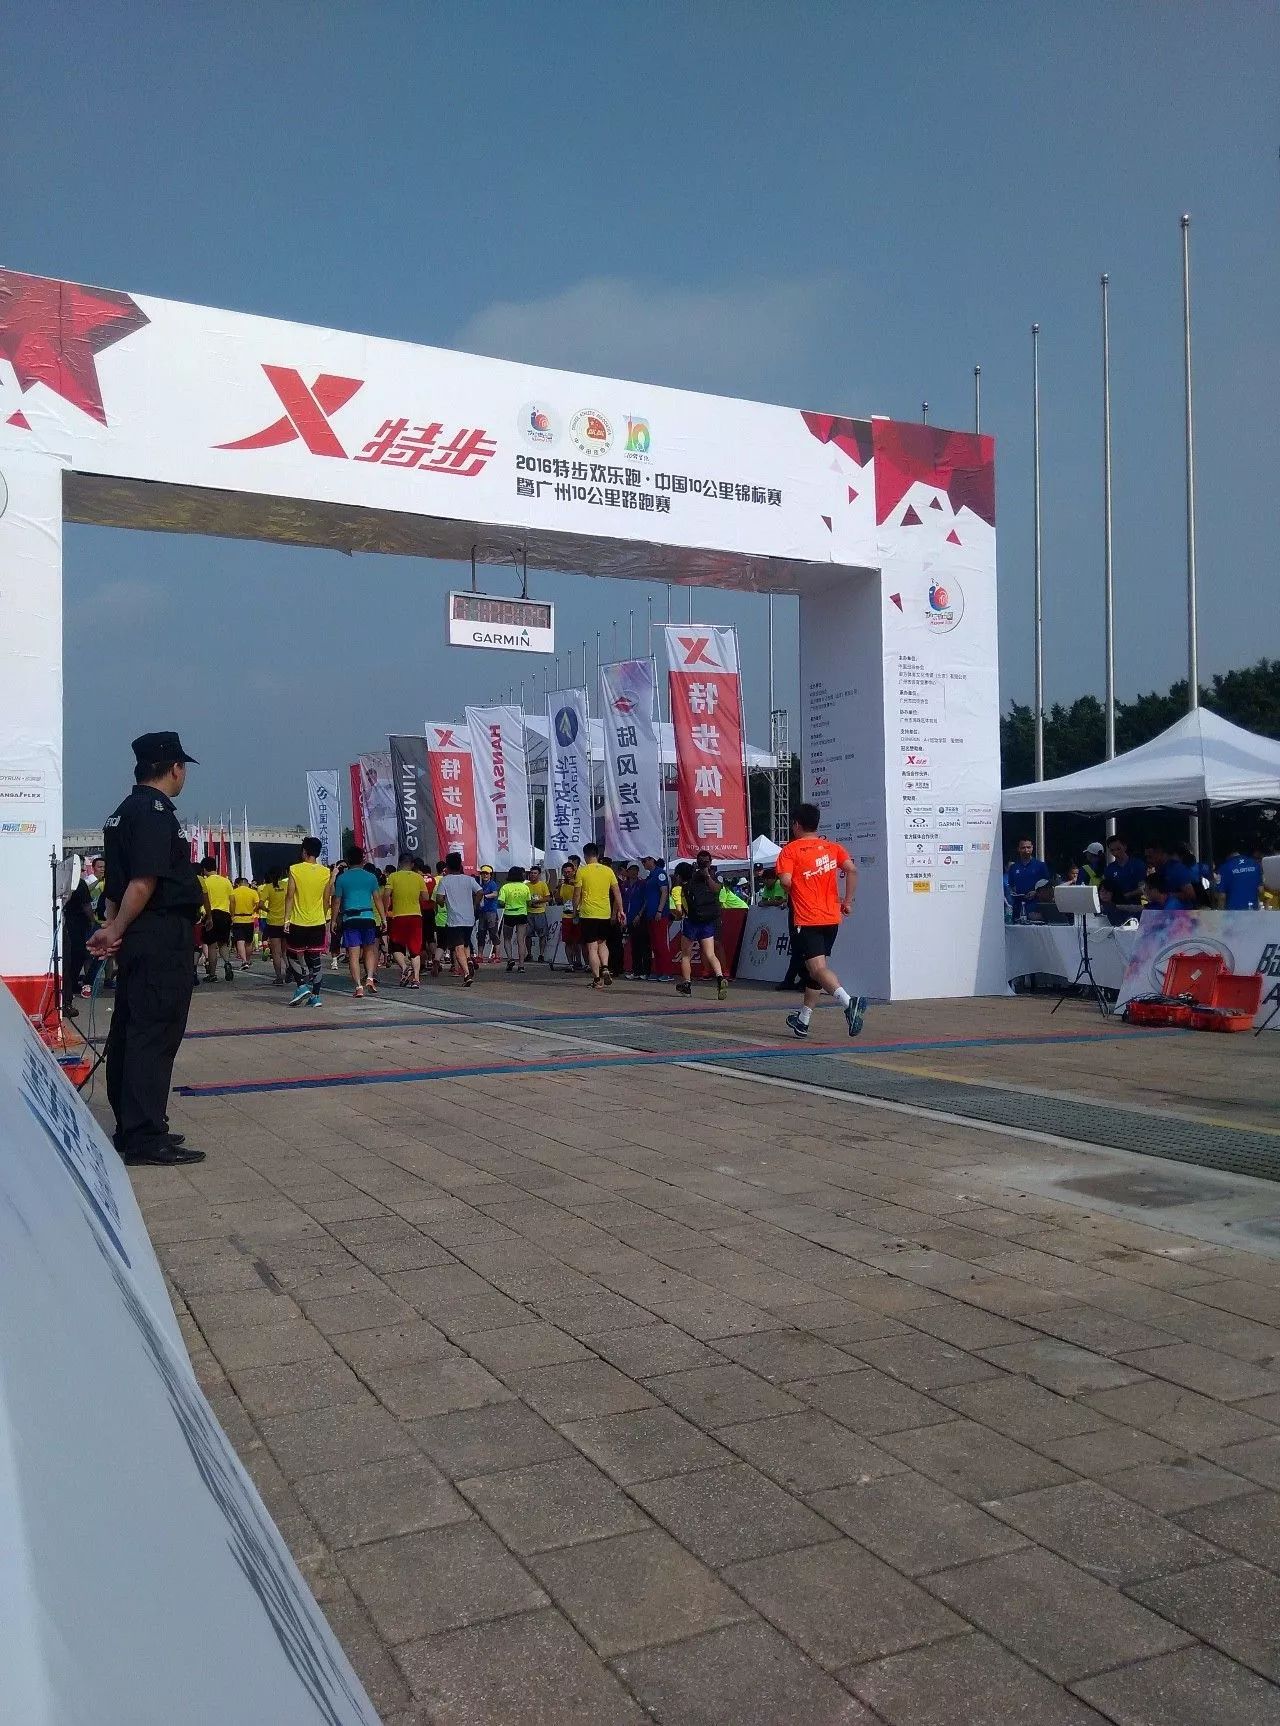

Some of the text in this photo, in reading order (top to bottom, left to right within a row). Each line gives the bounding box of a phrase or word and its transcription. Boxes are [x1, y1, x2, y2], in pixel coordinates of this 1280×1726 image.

[353, 418, 498, 477] 特步
[516, 477, 671, 514] 暨广州10公里路跑赛
[472, 631, 530, 647] GARMIN
